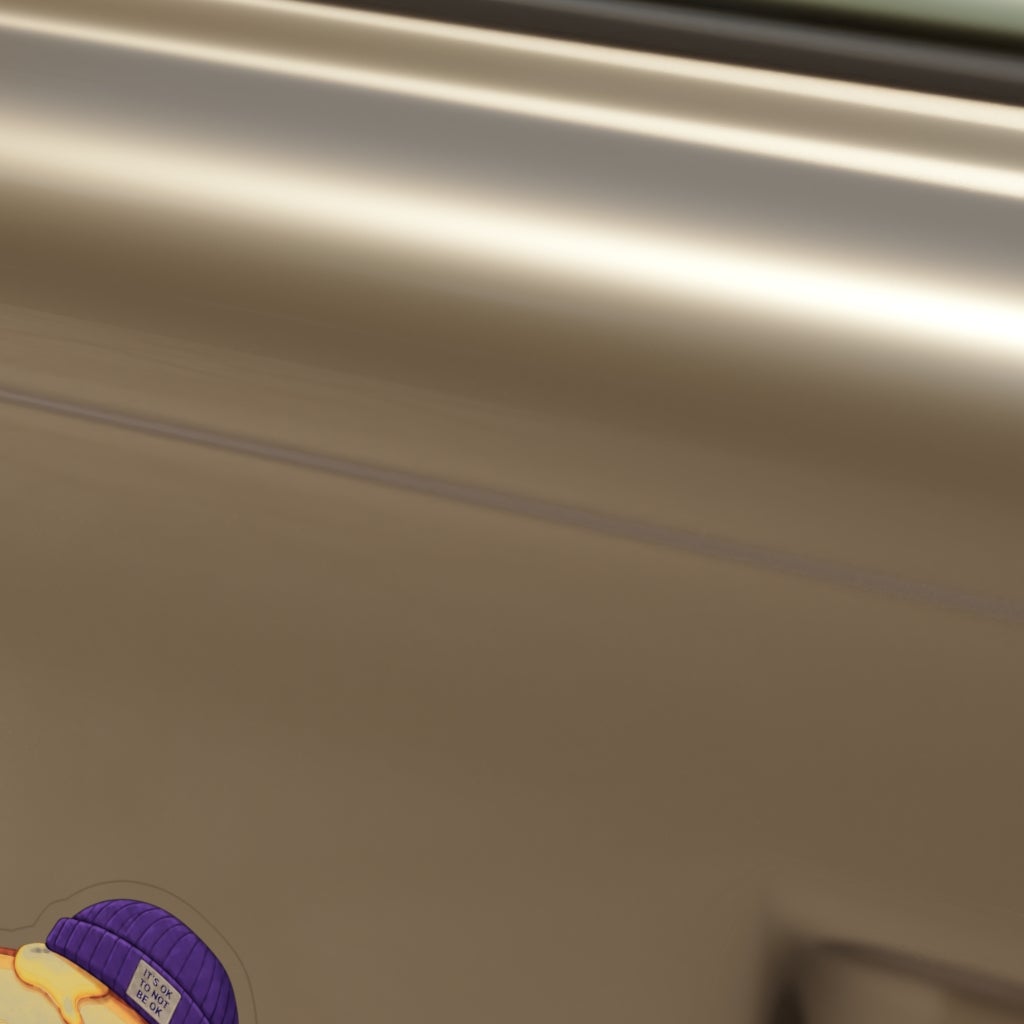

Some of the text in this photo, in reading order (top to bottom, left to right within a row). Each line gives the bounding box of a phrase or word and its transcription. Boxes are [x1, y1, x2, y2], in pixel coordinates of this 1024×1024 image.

[140, 978, 169, 1009] TO NOT
[143, 969, 173, 1000] IT'S OK
[136, 990, 163, 1017] BE OK
